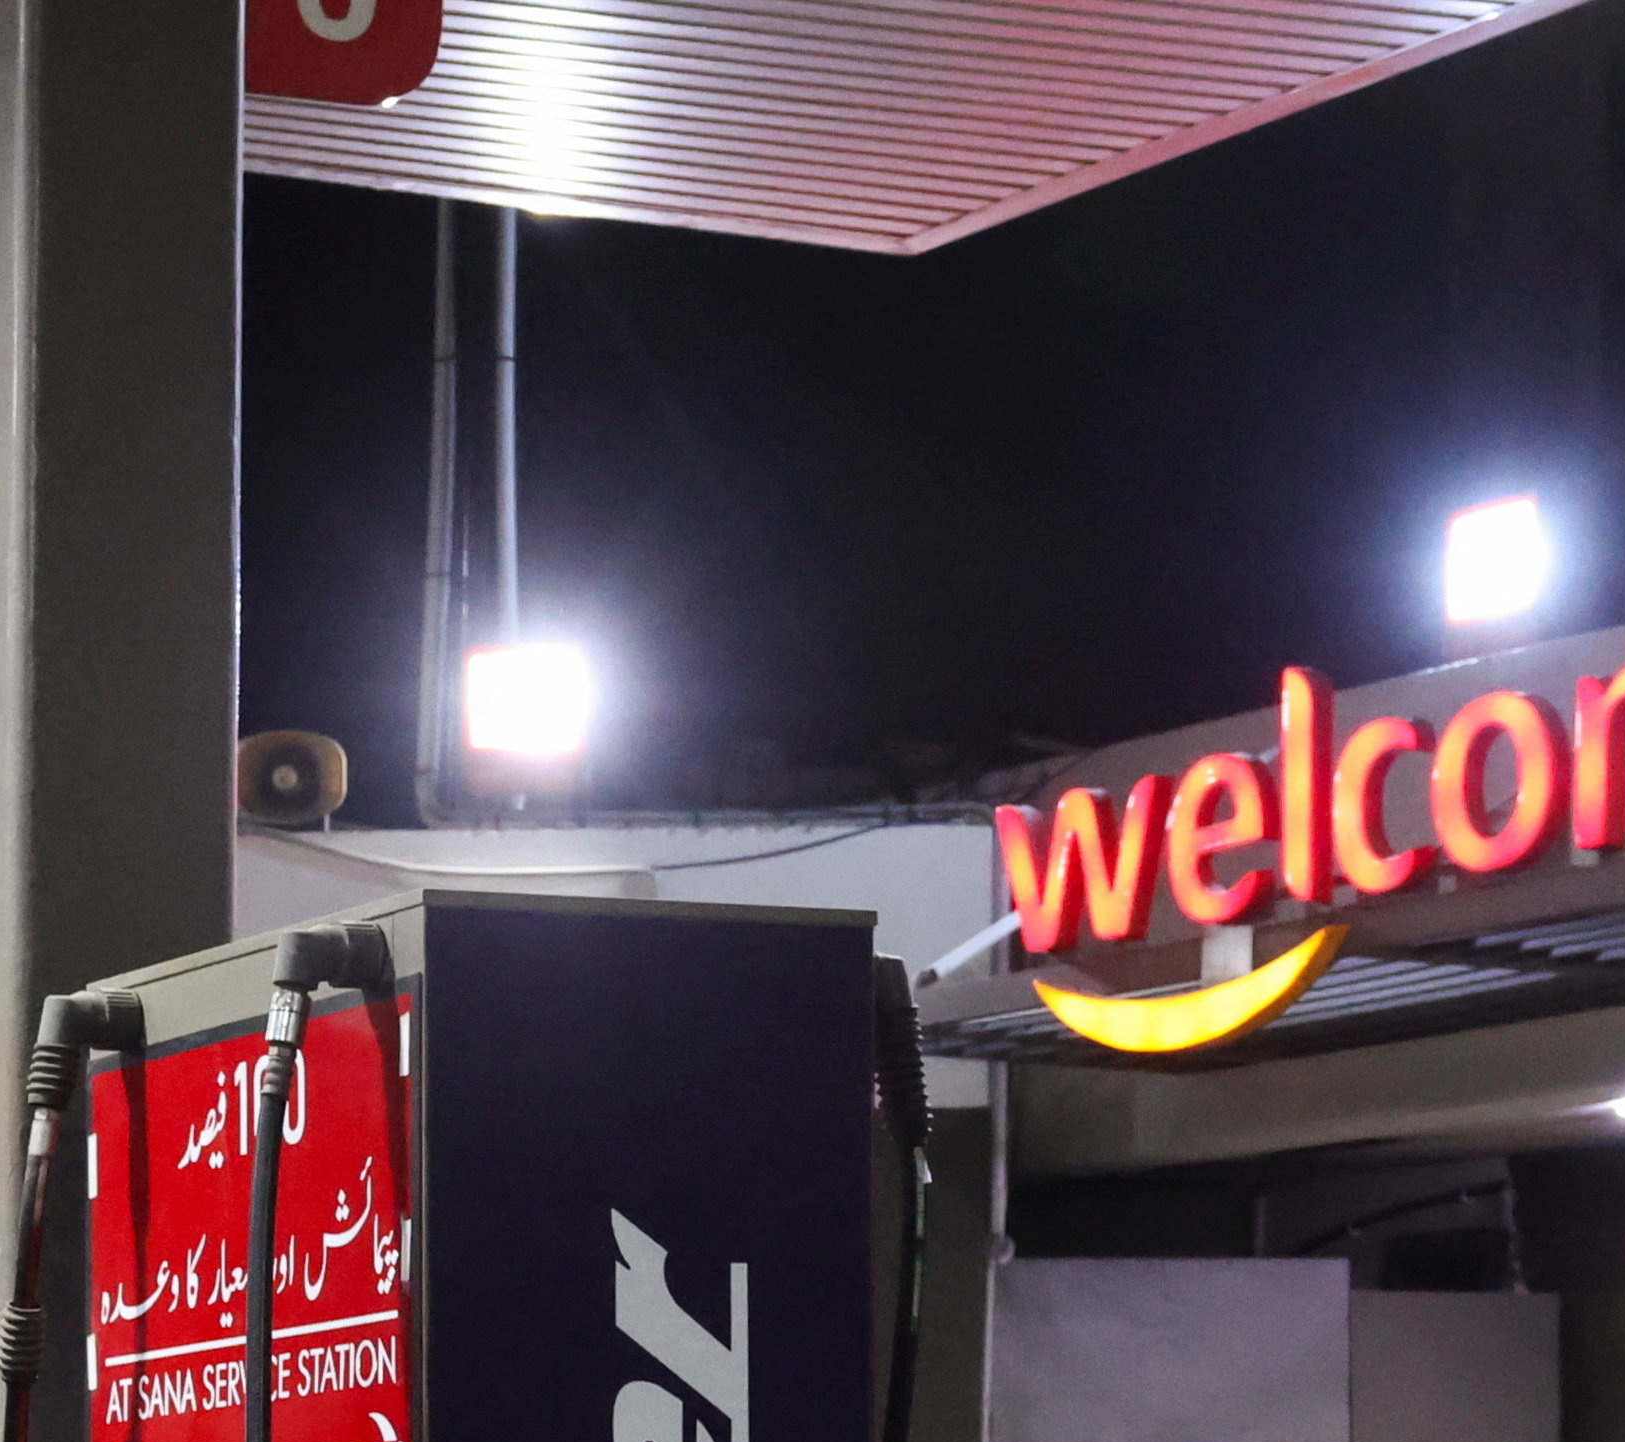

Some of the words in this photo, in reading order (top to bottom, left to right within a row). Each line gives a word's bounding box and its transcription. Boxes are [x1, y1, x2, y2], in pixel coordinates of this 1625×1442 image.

[177, 1070, 227, 1170] فیصد
[104, 1378, 133, 1424] AT
[137, 1367, 197, 1421] SANA
[296, 1335, 398, 1397] STATION
